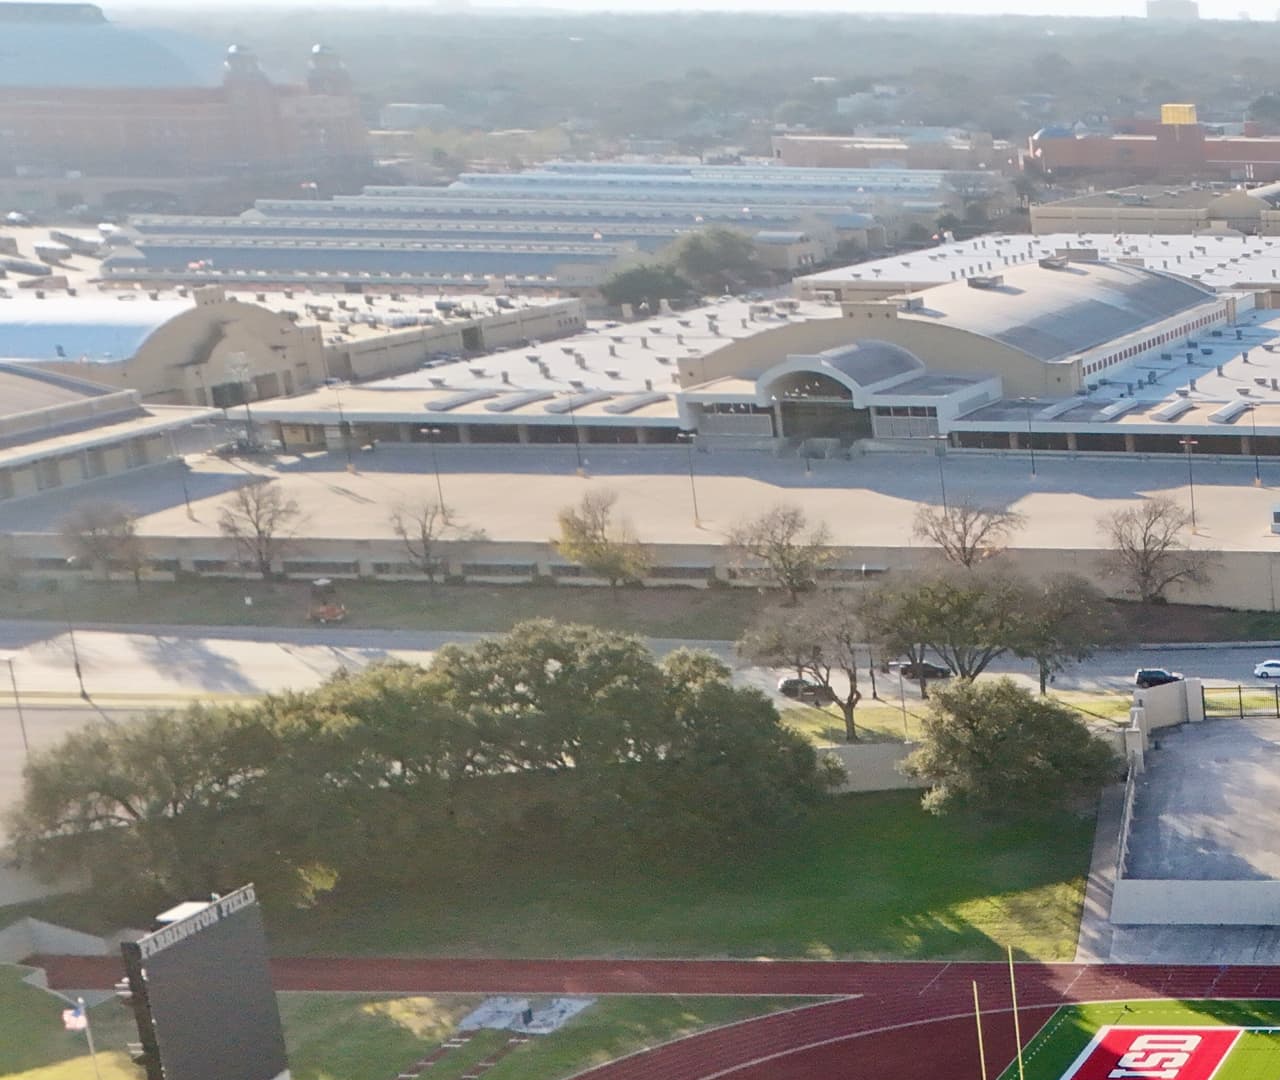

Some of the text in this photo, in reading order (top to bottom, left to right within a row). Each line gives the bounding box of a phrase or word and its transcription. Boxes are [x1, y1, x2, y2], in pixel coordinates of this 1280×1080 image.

[140, 887, 256, 960] FARRINGTON FIELD
[1109, 1034, 1203, 1080] ISD
